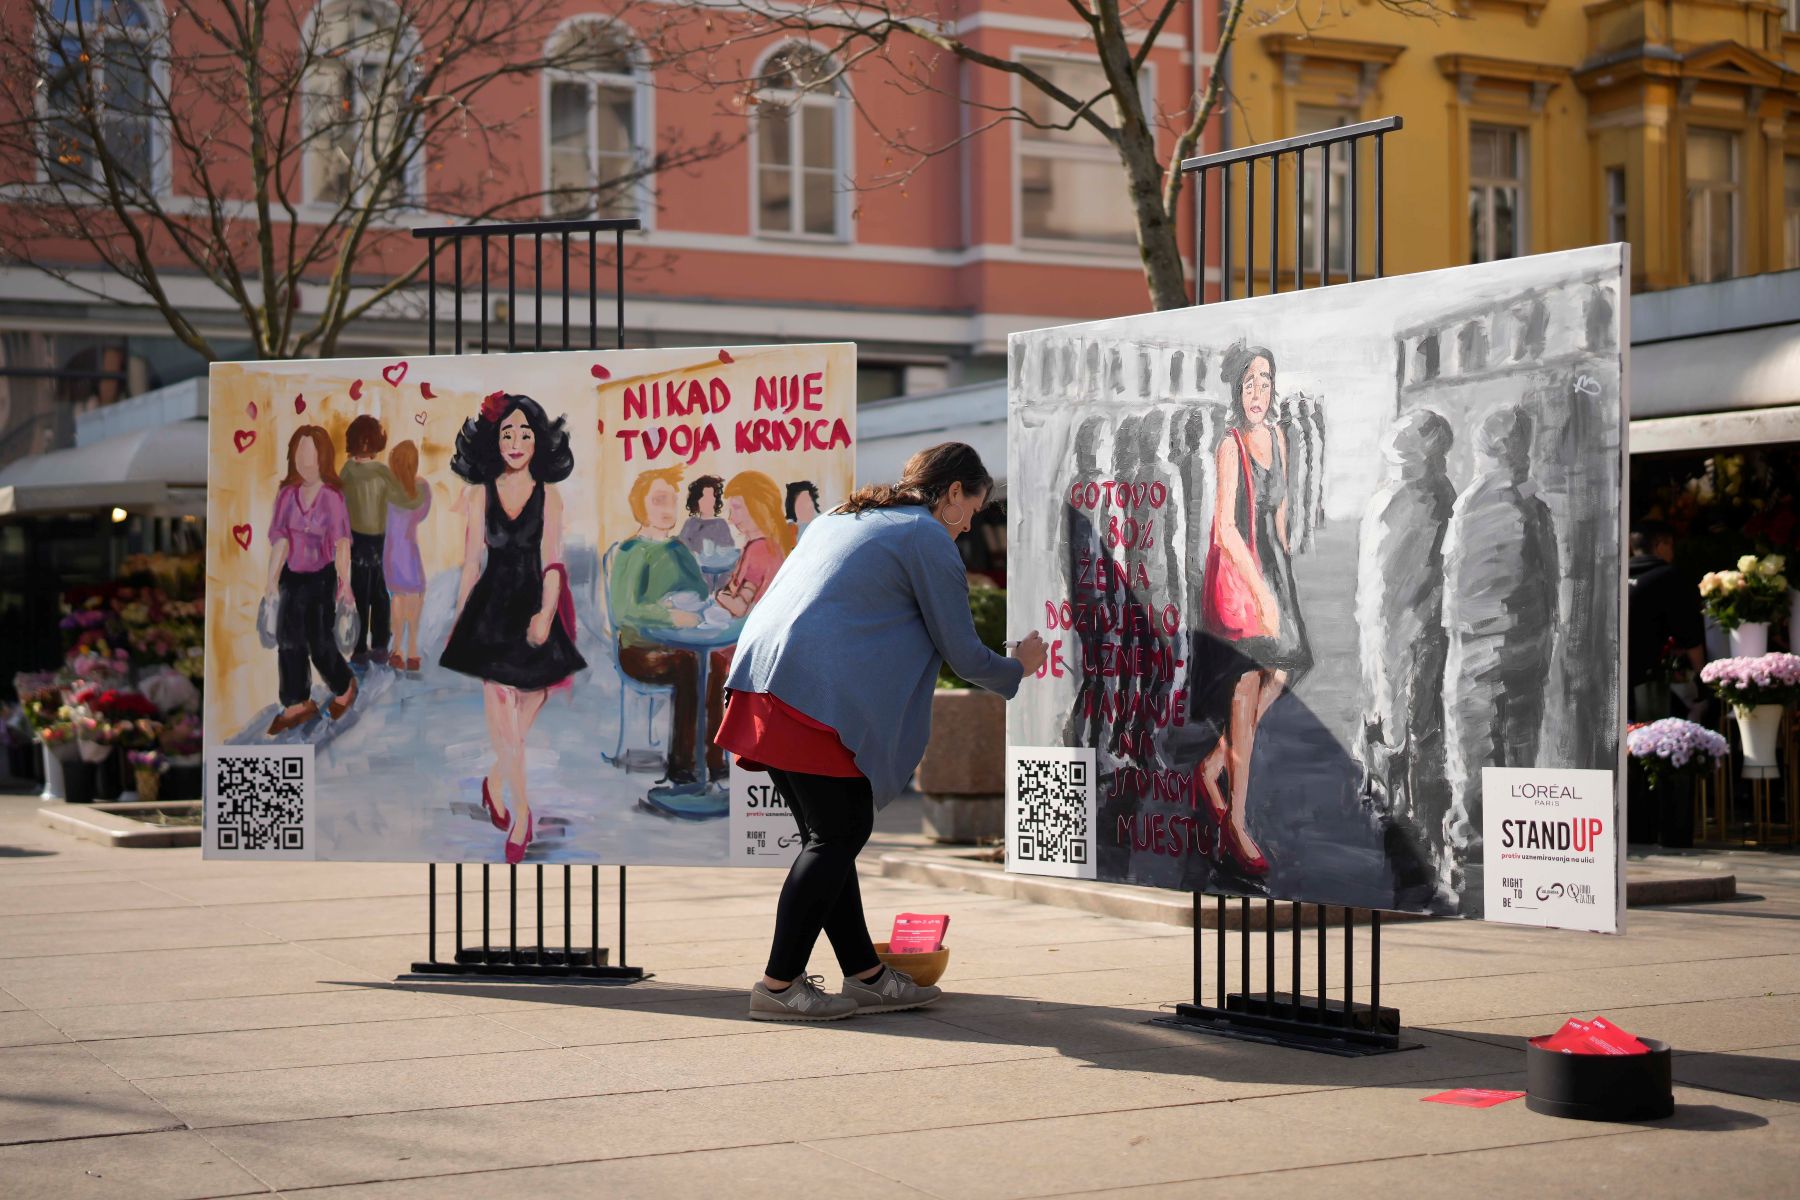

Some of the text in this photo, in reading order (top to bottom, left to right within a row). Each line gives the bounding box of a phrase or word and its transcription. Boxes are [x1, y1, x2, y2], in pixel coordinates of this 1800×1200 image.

[623, 372, 823, 421] NIKAD NIJE
[615, 417, 852, 465] TVOJA KRIVICA
[1070, 480, 1167, 510] GOTOVO
[1107, 515, 1154, 550] 80%
[1118, 729, 1156, 759] NA
[746, 831, 766, 839] RIGHT
[757, 839, 766, 848] TO
[1116, 811, 1213, 858] MJESTU
[1501, 817, 1603, 853] STANDUP
[747, 847, 755, 855] BE
[1501, 852, 1521, 860] protiv
[1502, 877, 1524, 889] RIGHT
[1502, 897, 1512, 908] BE
[1514, 889, 1523, 899] TO
